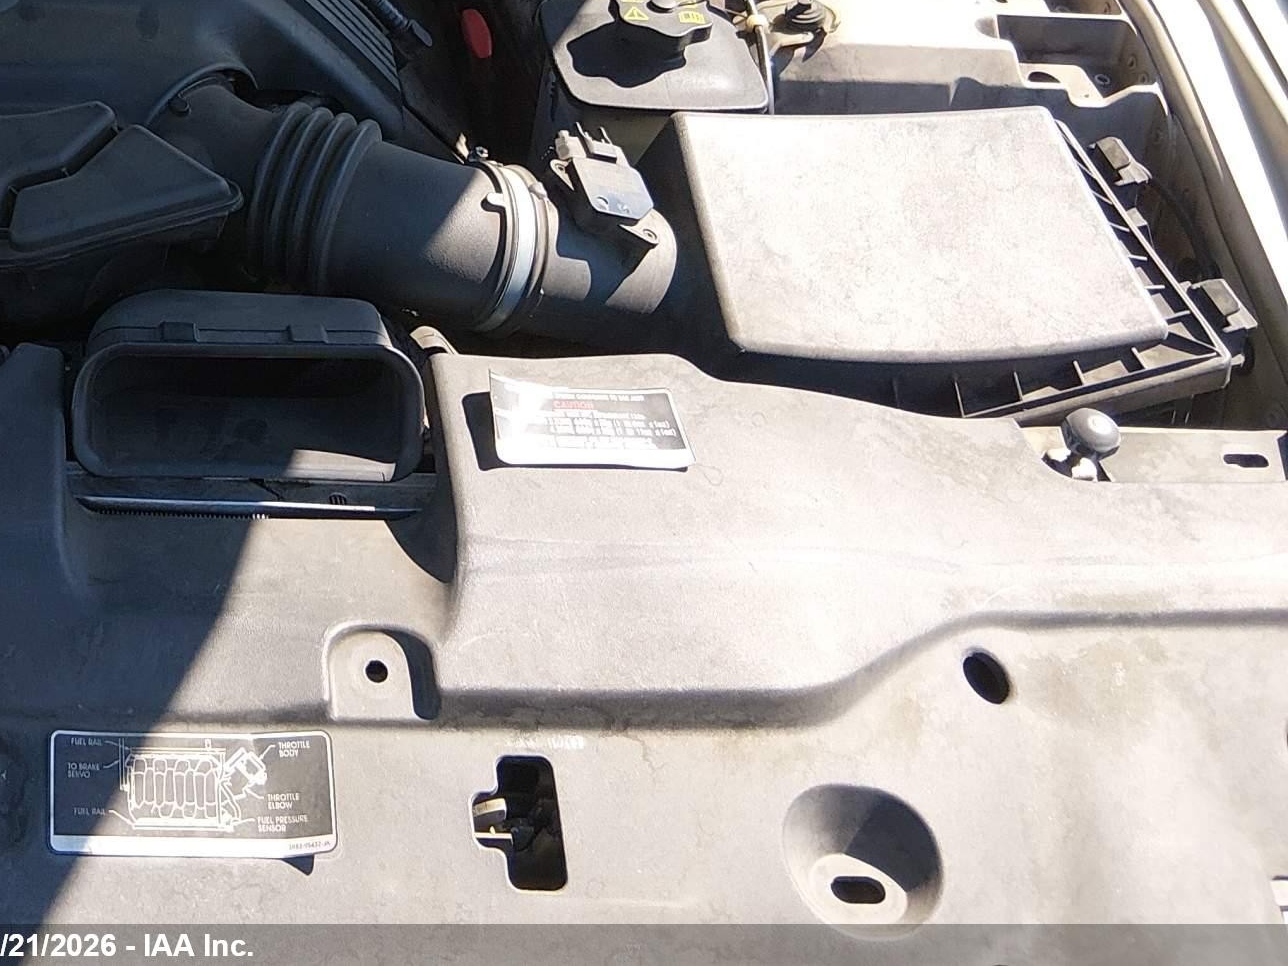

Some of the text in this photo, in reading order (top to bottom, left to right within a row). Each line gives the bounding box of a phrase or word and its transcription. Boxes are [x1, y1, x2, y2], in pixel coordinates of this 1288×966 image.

[278, 740, 311, 749] THROTTLE
[279, 749, 300, 758] BODY
[67, 762, 101, 772] TO BRAKE
[267, 792, 300, 802] THROTTLE
[267, 801, 293, 811] ELBOW
[257, 814, 309, 825] FUEL PRESSURE
[257, 824, 287, 833] SENSOR
